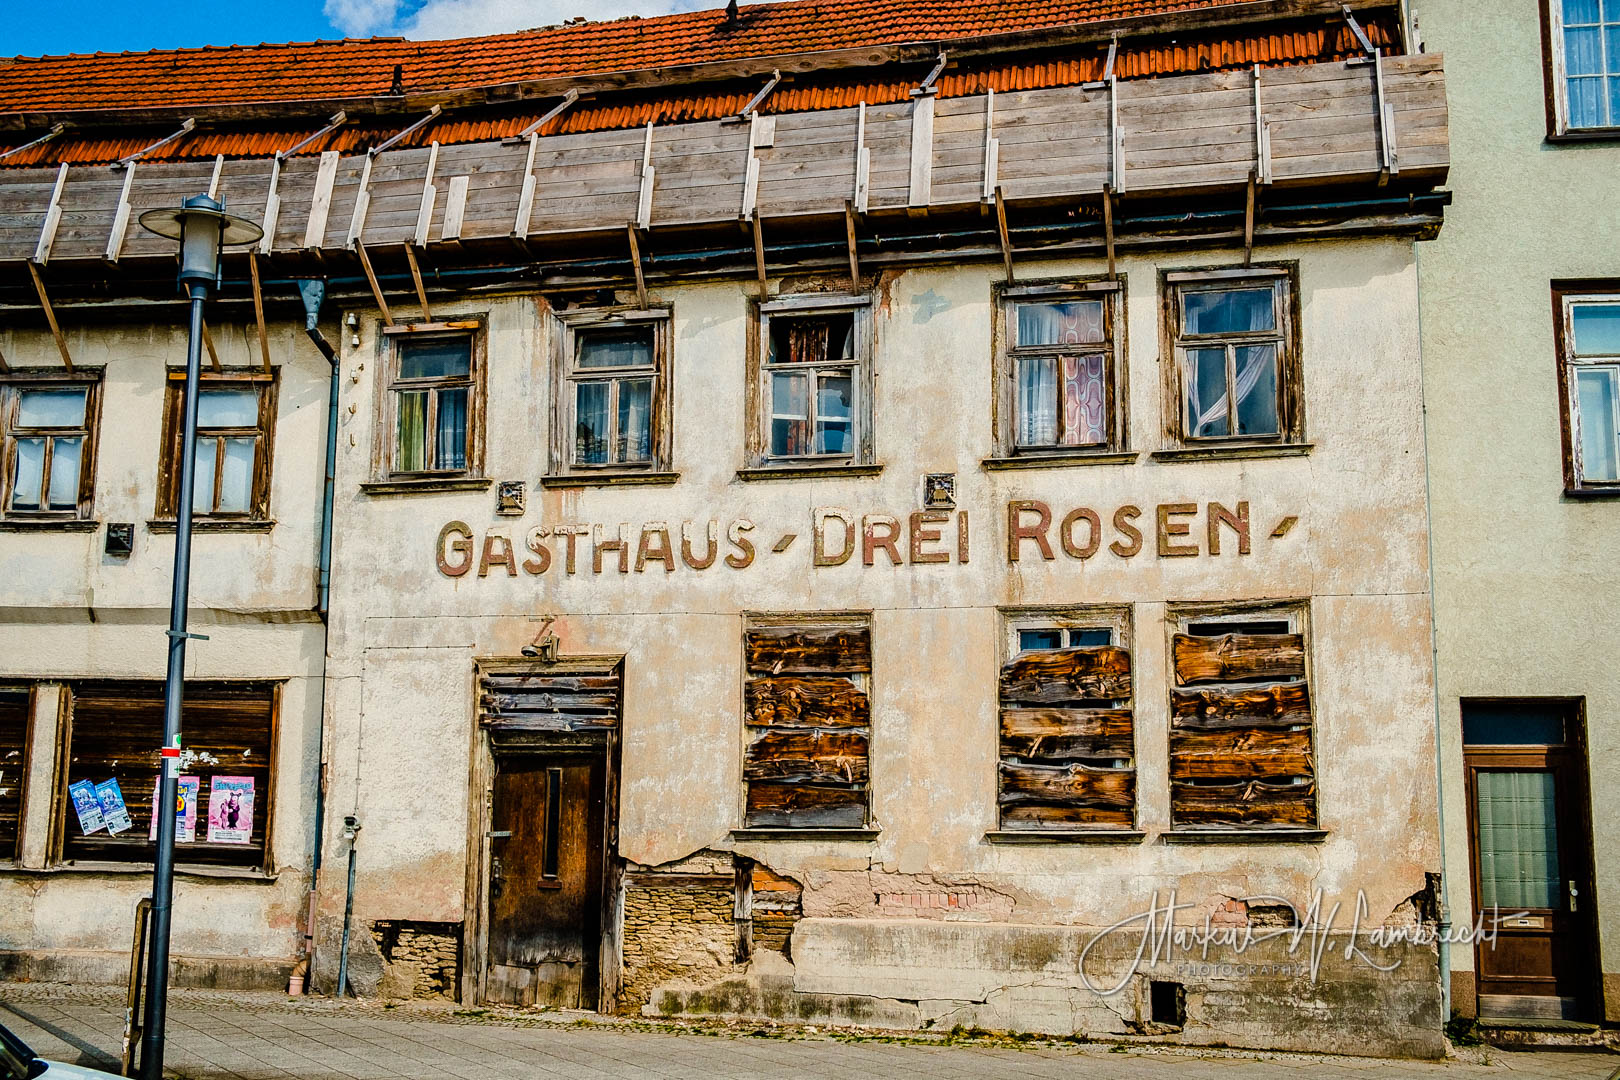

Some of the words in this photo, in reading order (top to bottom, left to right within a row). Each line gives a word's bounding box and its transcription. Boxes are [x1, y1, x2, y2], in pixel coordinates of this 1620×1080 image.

[436, 519, 756, 577] GASTHAUS
[813, 505, 971, 567] DREI
[1008, 500, 1251, 562] ROSEN
